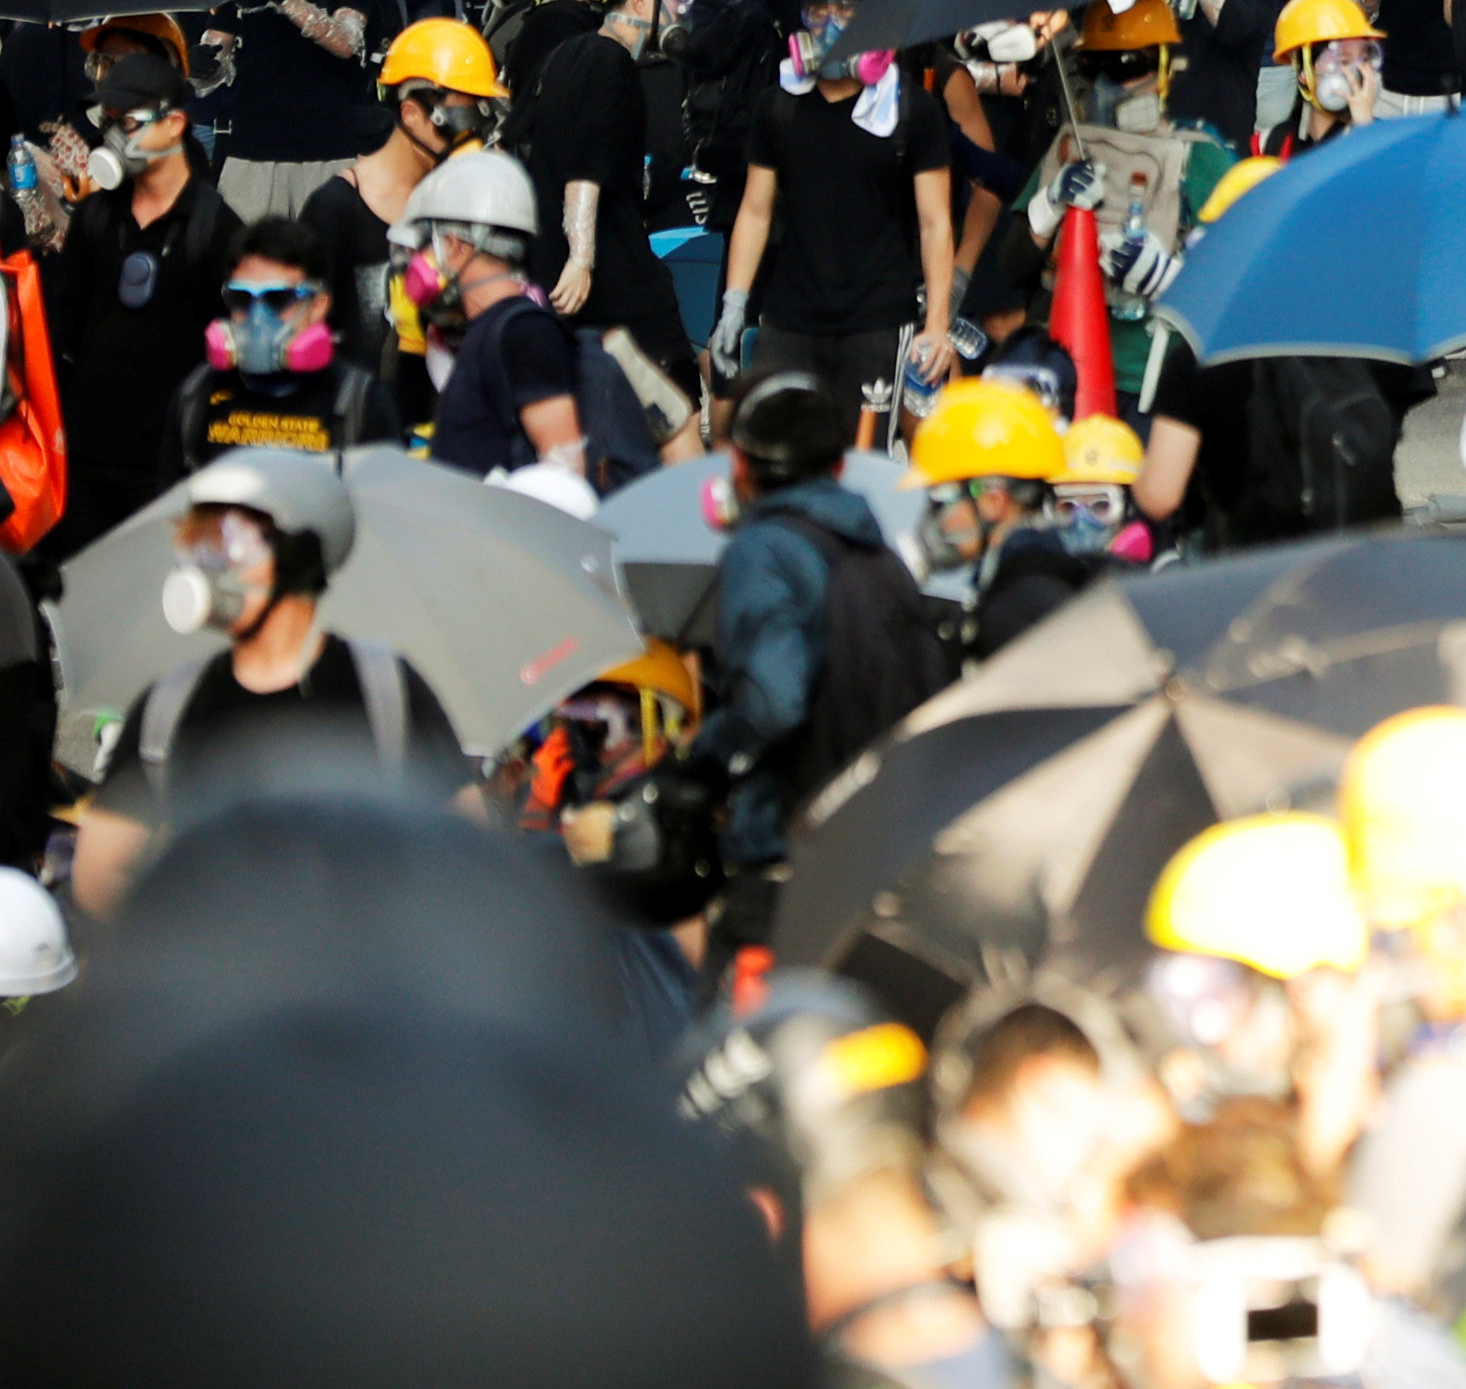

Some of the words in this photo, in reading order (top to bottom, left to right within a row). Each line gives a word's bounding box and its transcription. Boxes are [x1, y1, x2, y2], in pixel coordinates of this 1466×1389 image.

[228, 411, 279, 428] GOLDEN
[281, 416, 319, 432] STATE
[207, 421, 330, 451] WARRIORS
